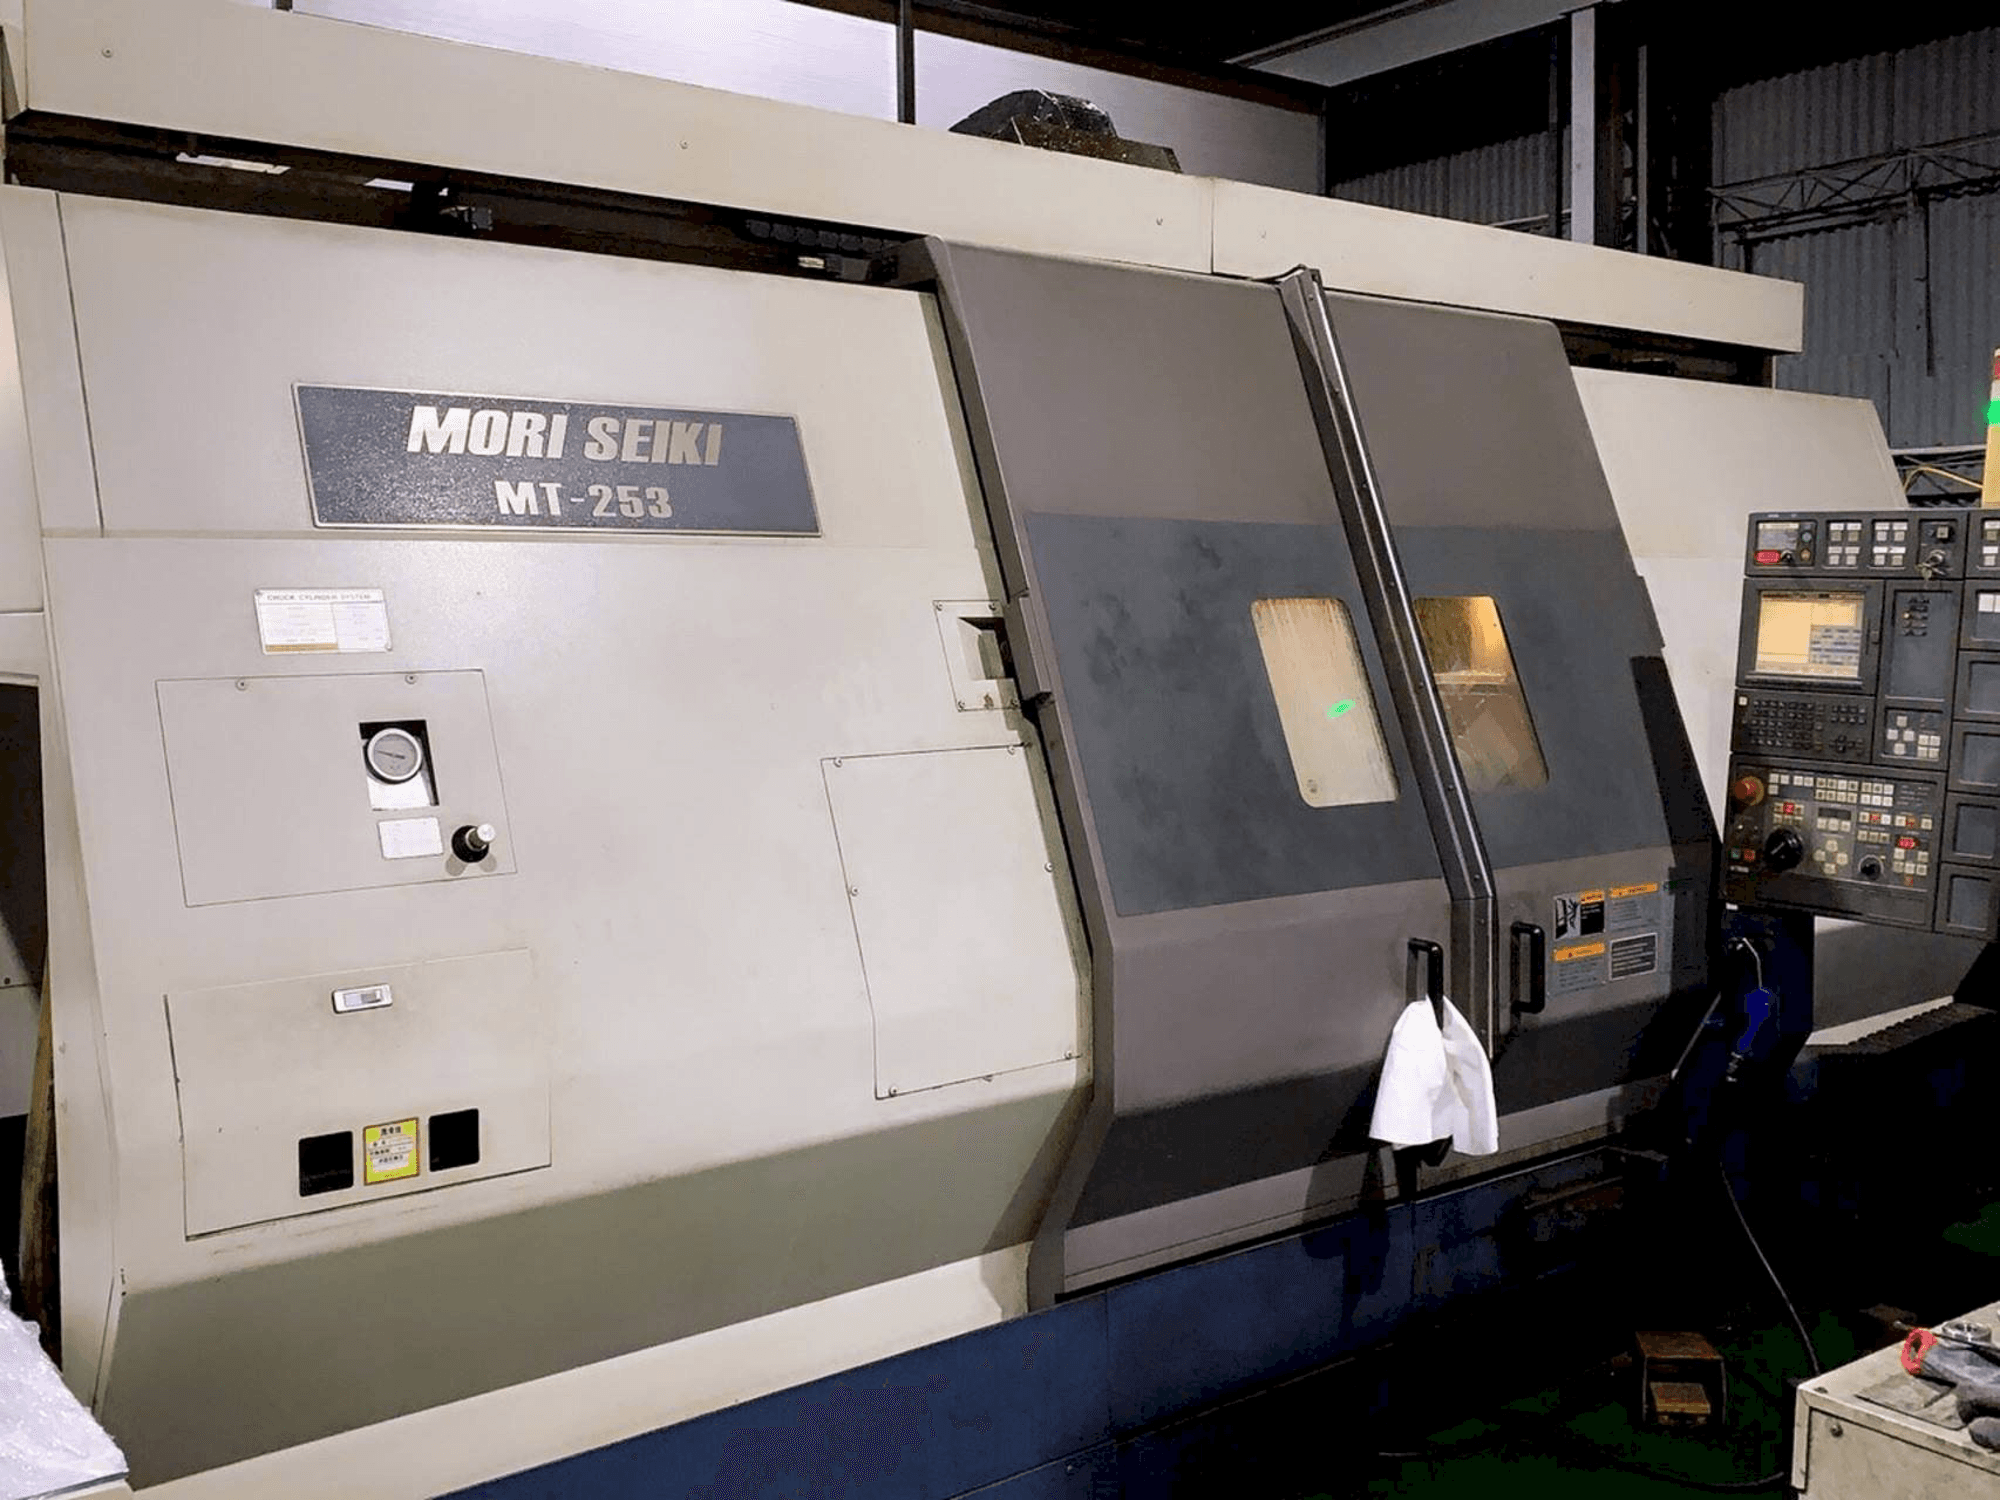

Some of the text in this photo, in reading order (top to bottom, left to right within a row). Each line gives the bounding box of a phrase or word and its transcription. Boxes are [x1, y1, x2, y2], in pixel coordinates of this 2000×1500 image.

[406, 405, 723, 466] MORI SEIKI
[494, 480, 674, 519] MT-253
